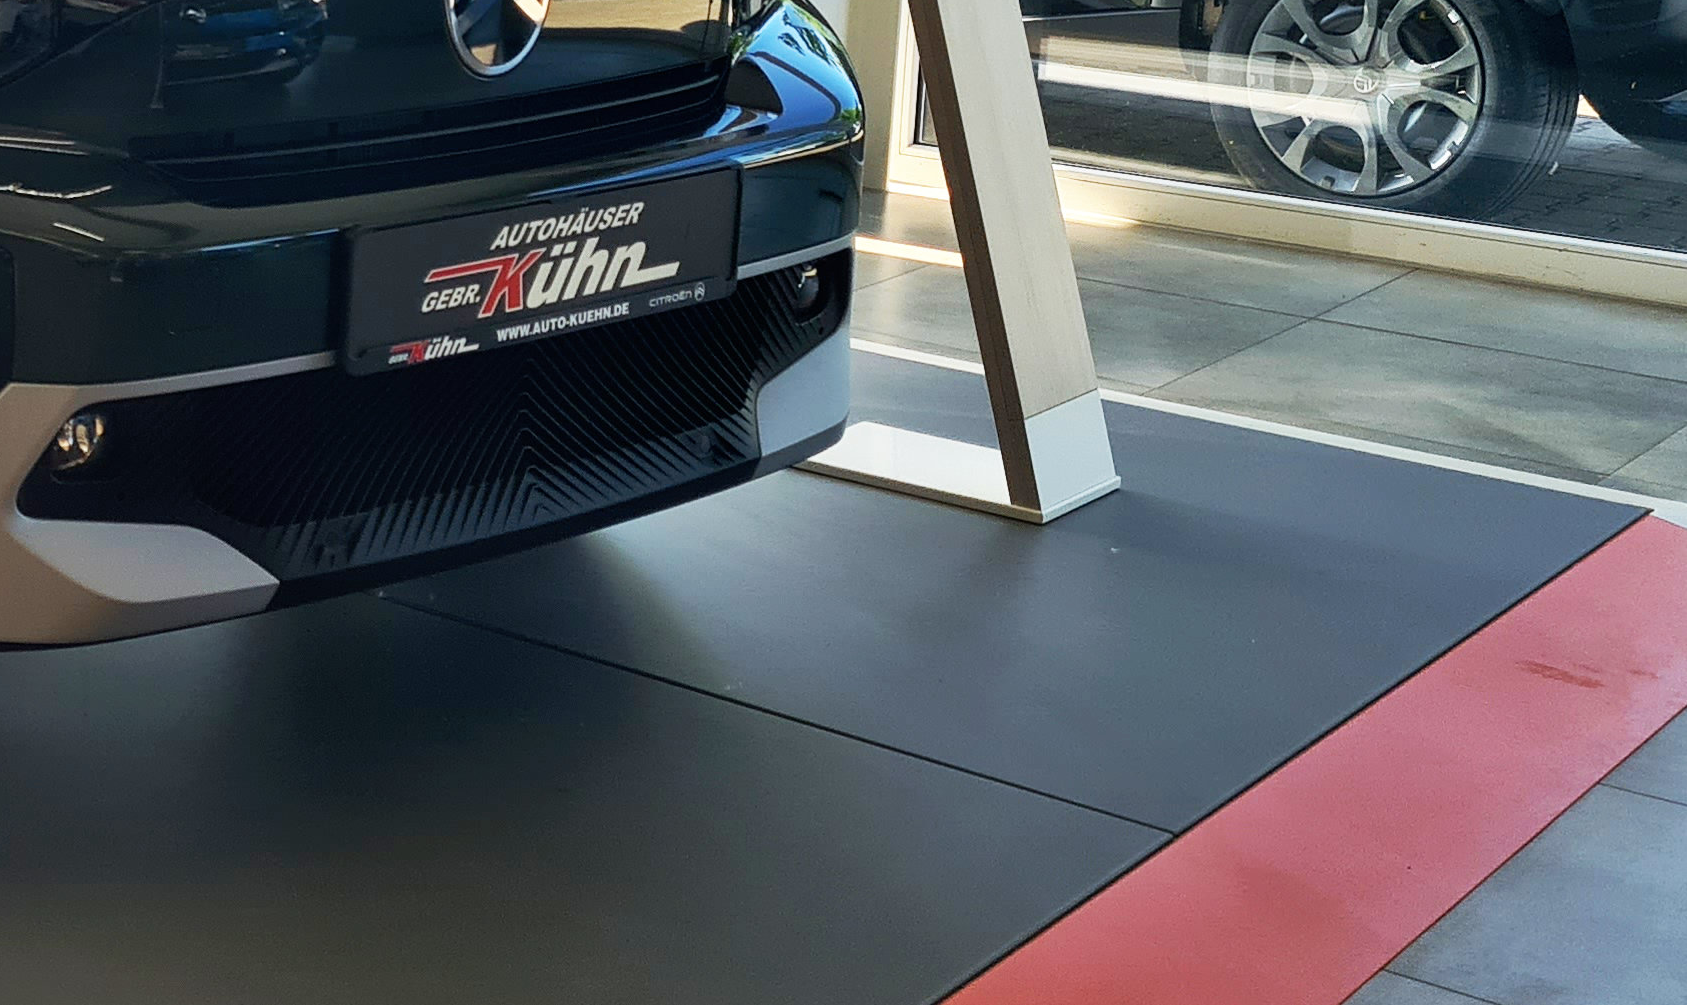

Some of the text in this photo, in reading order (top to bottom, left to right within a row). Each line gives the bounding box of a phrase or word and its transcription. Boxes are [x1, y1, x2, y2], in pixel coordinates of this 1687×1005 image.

[489, 201, 645, 251] AUTOHÄUSER
[421, 236, 681, 319] GEBR. Kühn
[496, 302, 631, 343] WWW.AUTO-KUEHN.DE
[389, 335, 480, 365] Kühn
